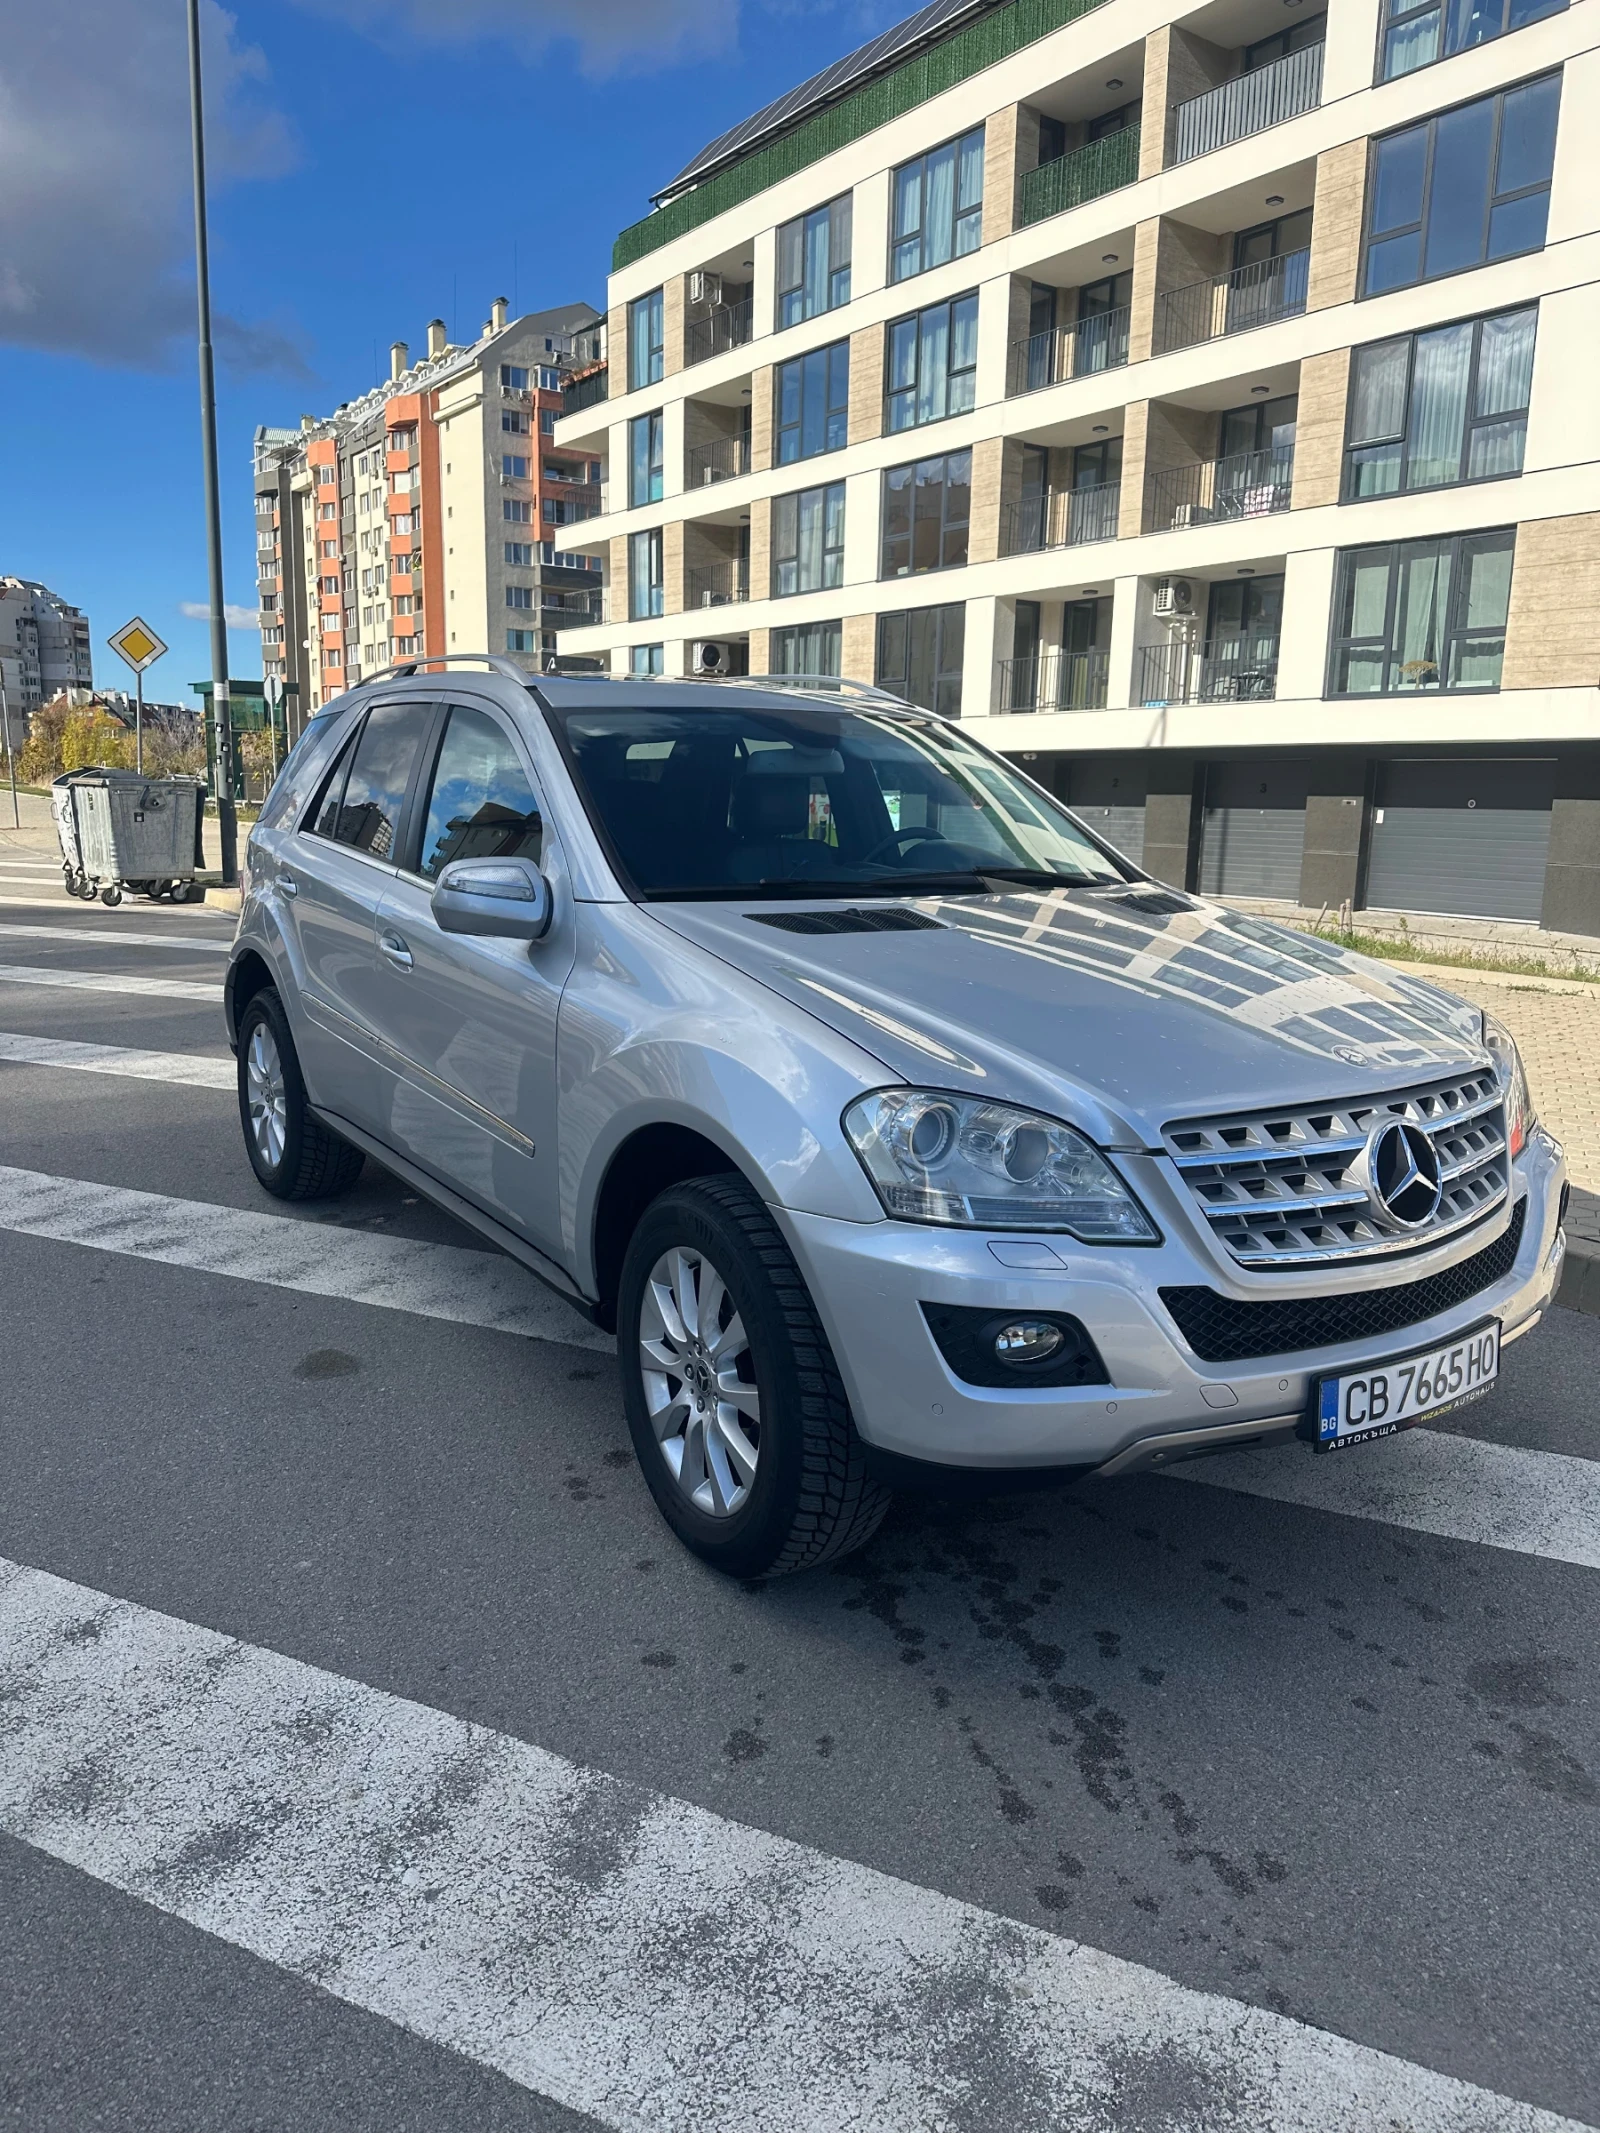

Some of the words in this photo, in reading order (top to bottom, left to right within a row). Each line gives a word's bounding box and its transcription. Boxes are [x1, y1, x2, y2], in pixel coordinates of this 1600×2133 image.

[1260, 782, 1267, 794] 3
[1454, 1381, 1496, 1409] AUTOHAUS
[1321, 1417, 1337, 1433] BG
[1328, 1424, 1398, 1450] АВТОКЪЩА
